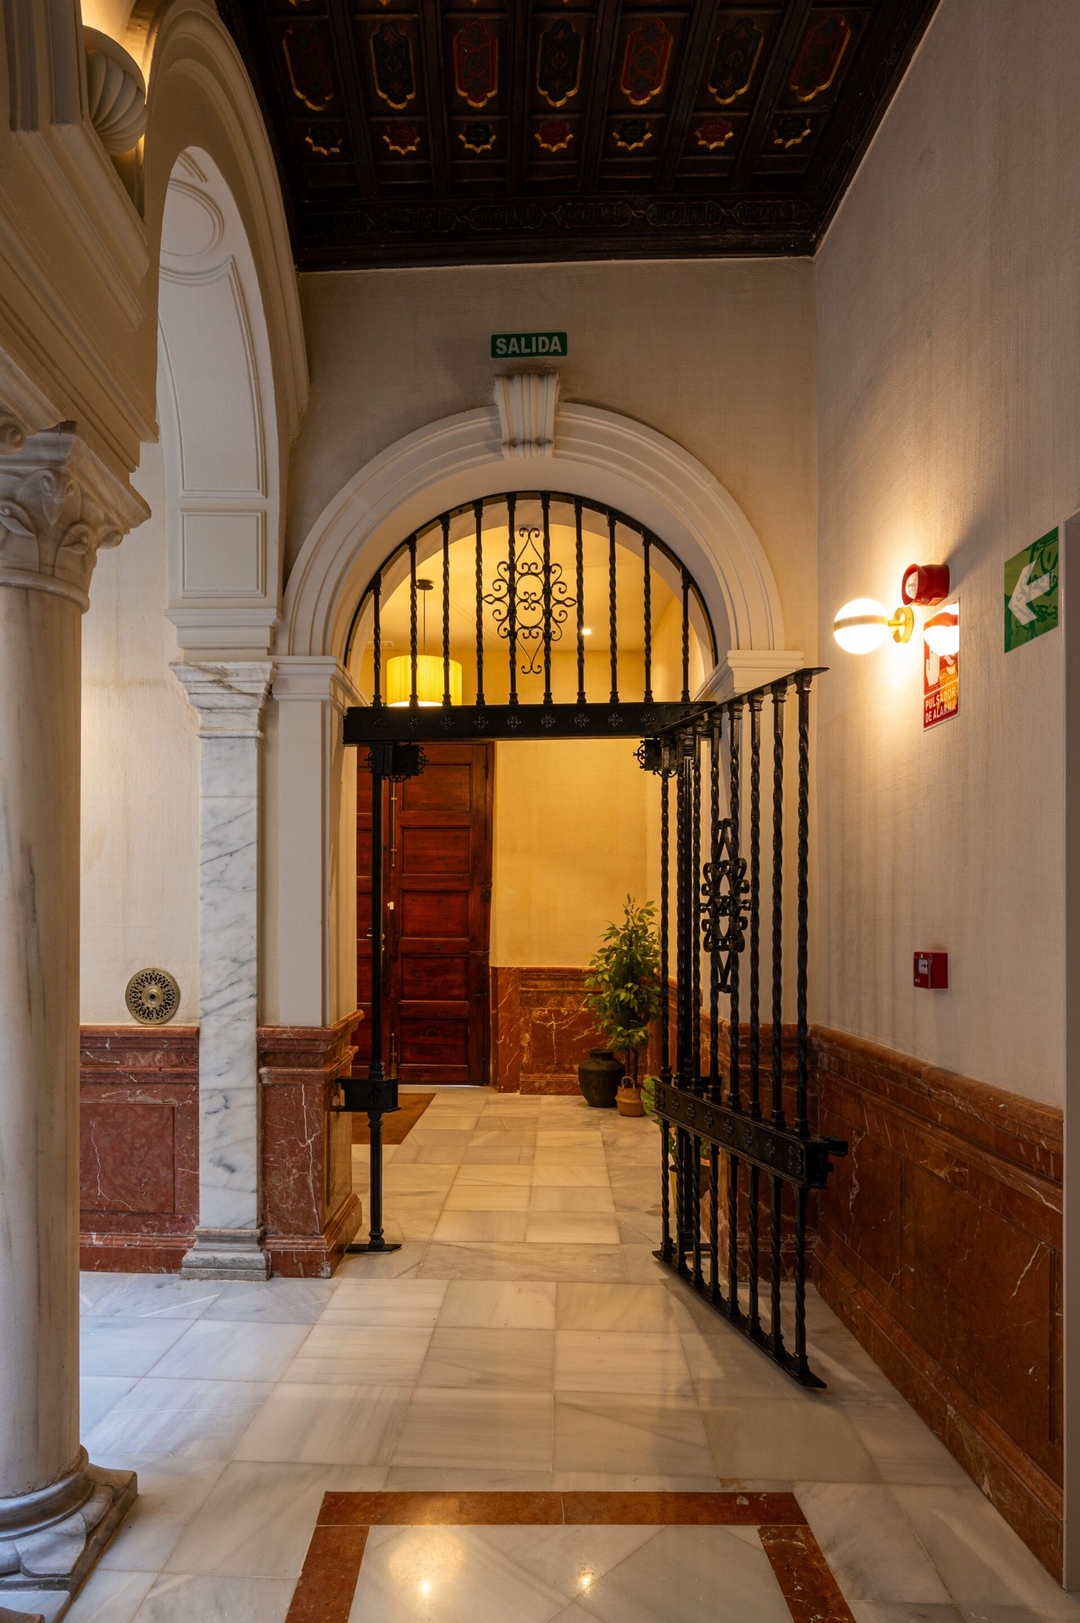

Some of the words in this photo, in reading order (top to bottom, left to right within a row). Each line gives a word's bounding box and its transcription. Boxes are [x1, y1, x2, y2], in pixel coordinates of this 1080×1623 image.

[496, 335, 562, 354] SALIDA
[925, 687, 957, 710] PULSADOR
[925, 710, 933, 723] DE
